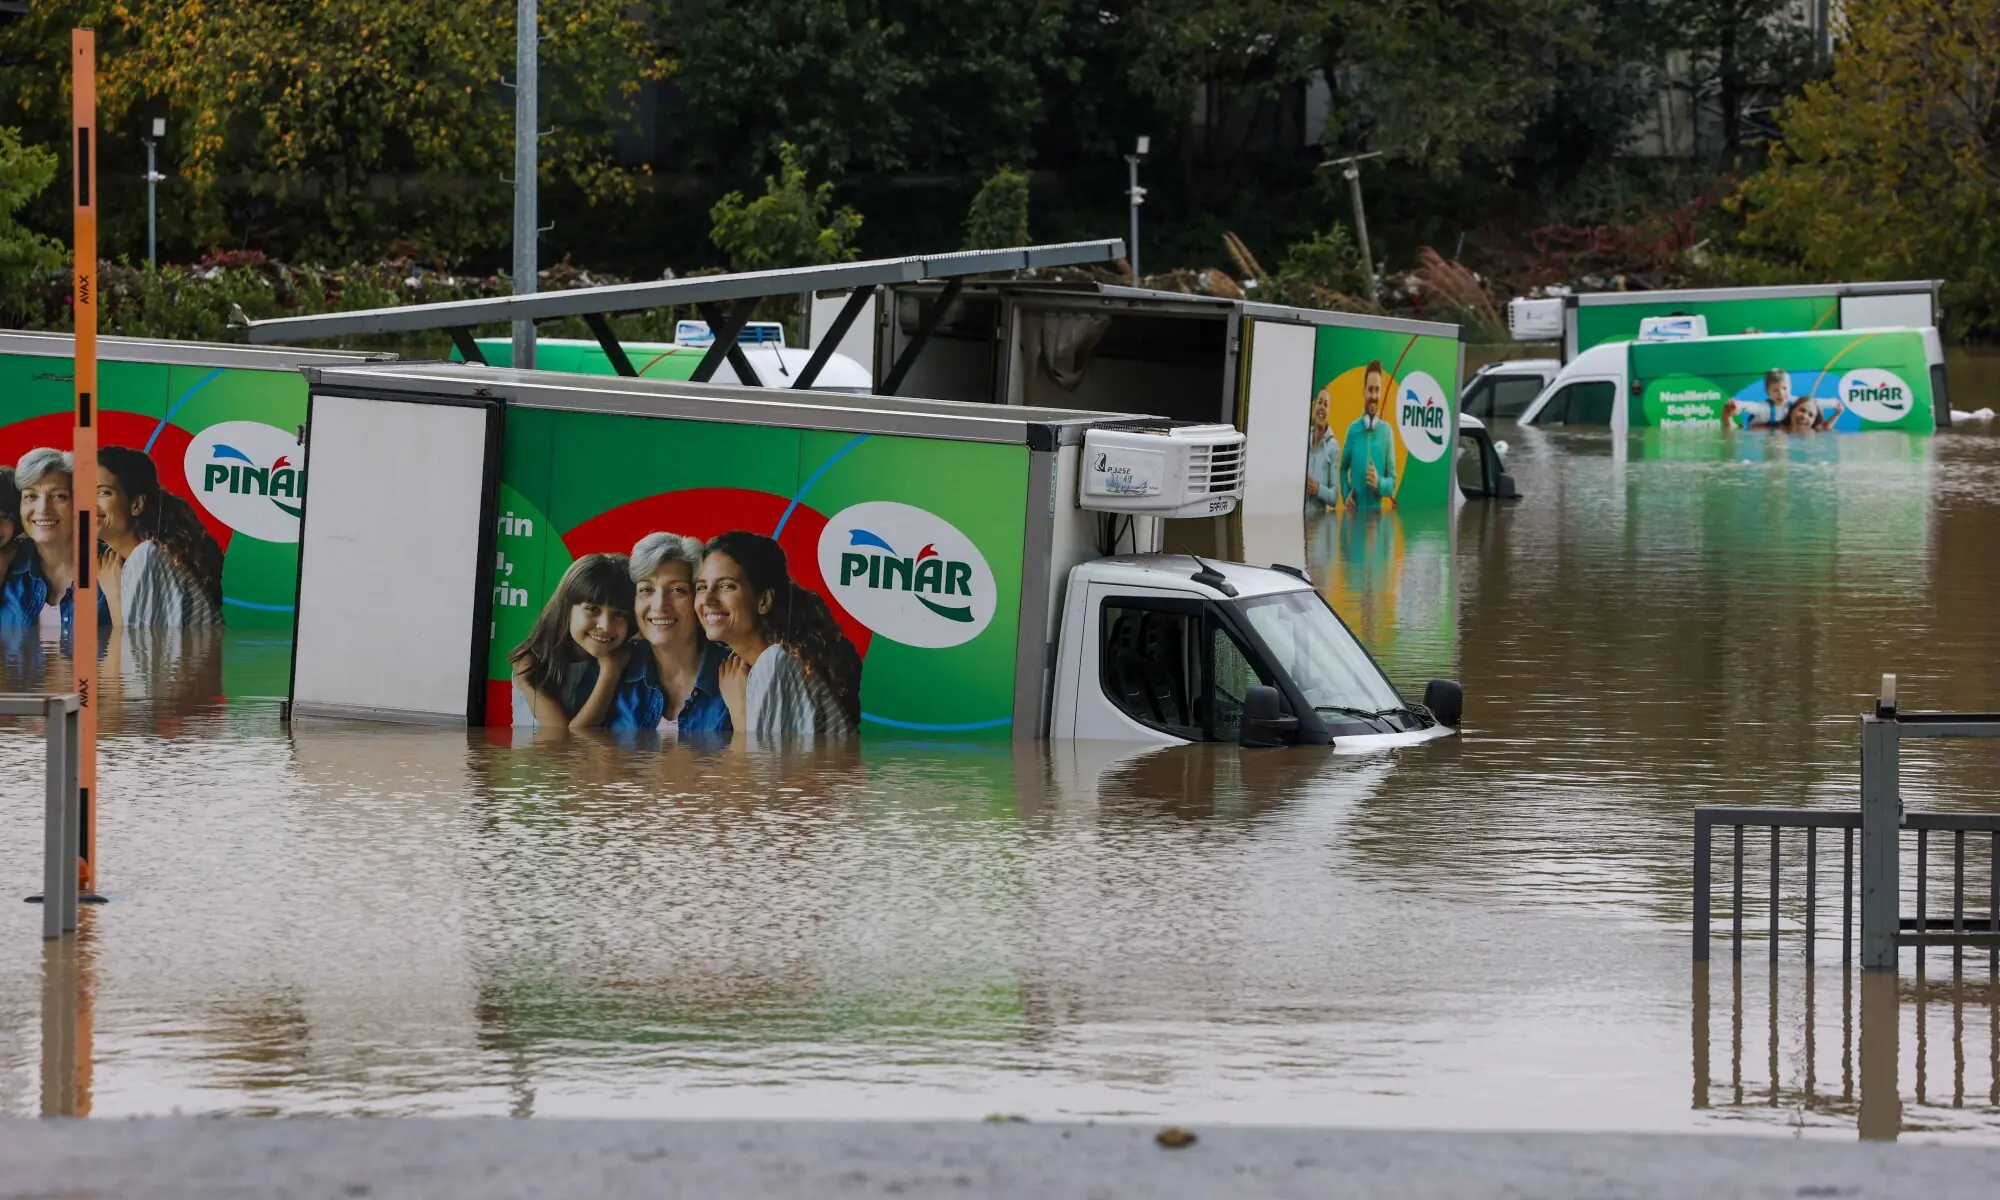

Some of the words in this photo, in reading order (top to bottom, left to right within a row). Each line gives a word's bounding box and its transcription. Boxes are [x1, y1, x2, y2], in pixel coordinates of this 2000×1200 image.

[80, 275, 90, 305] AVAX
[1660, 389, 1721, 402] Nesillerin
[1849, 382, 1903, 403] PINAR
[1402, 397, 1444, 429] PINAR
[204, 456, 304, 498] PINA
[840, 543, 973, 597] PINAR
[79, 678, 89, 708] AVAX
